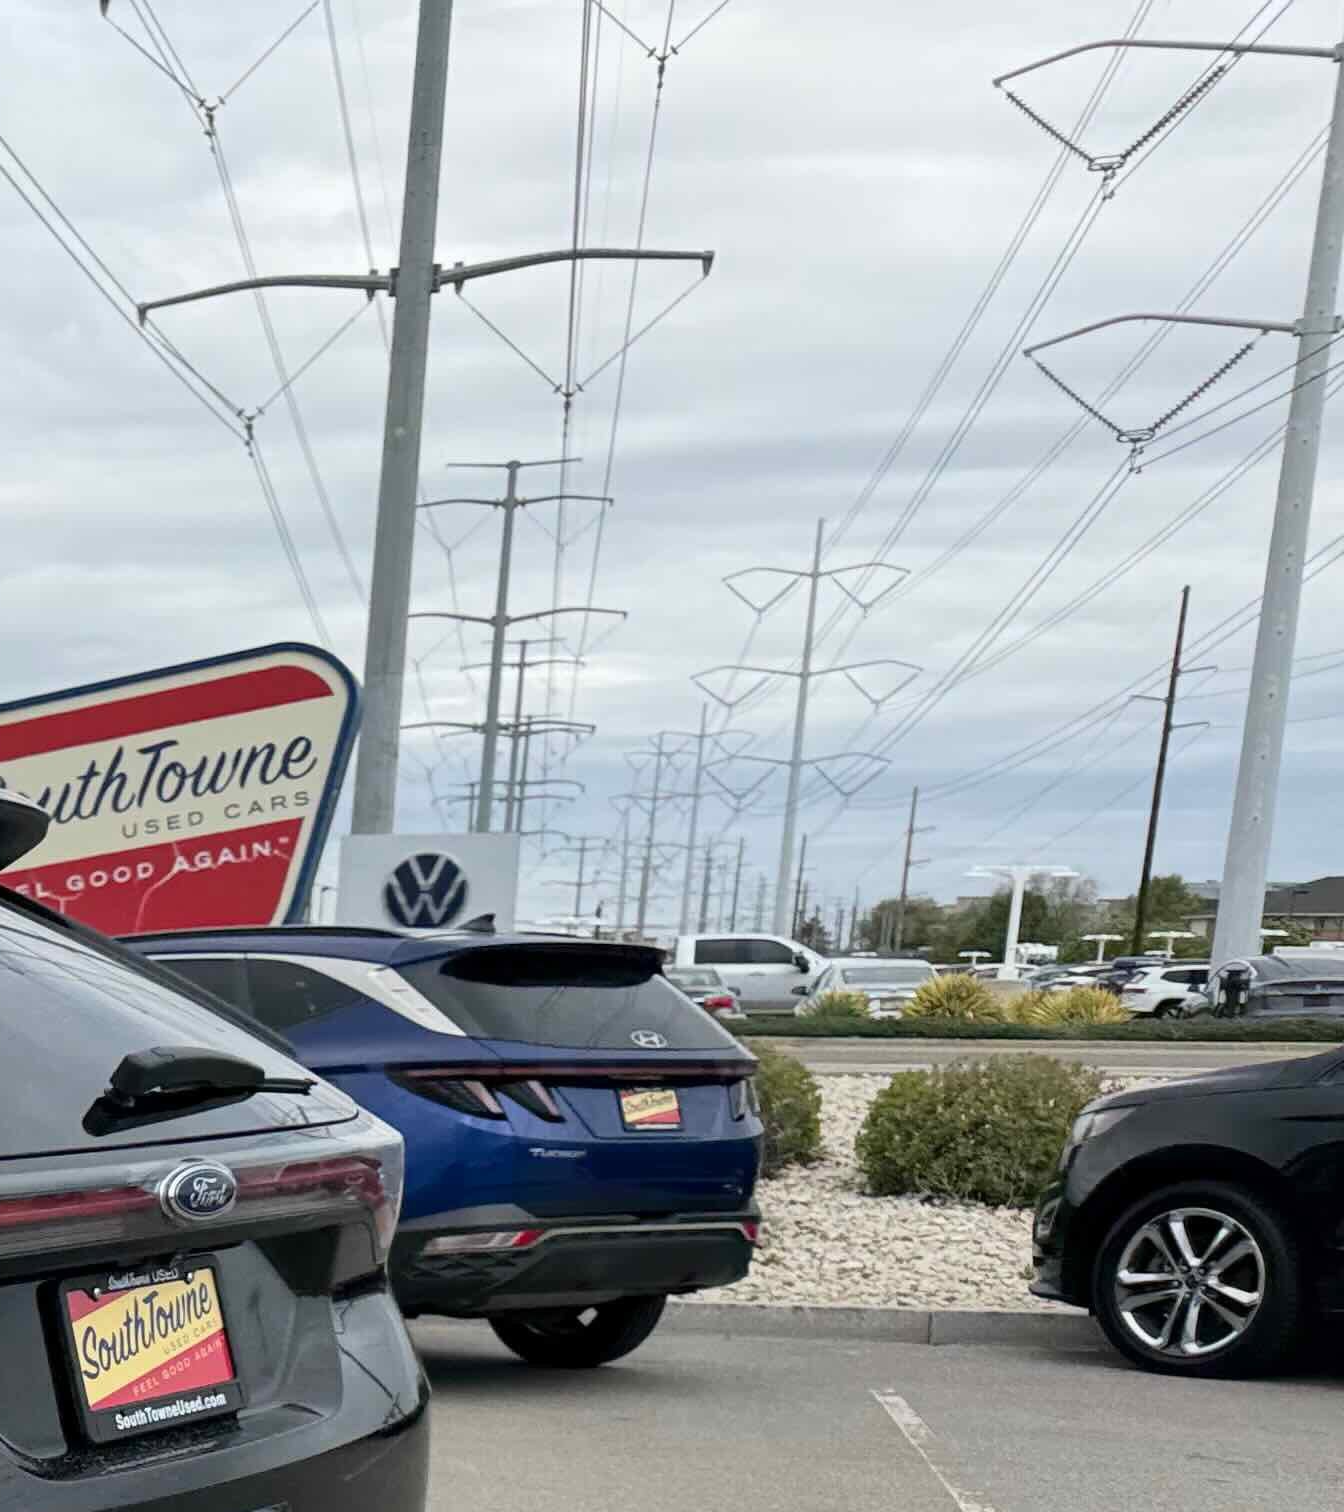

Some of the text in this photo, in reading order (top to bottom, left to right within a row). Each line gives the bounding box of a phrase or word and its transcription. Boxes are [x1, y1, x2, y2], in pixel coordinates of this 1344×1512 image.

[122, 790, 311, 839] USED CARS
[65, 862, 154, 892] GOOD
[82, 1282, 213, 1380] SouthTowne
[132, 1377, 160, 1397] FEEL
[161, 1357, 192, 1381] GOOD
[115, 1392, 227, 1431] SouthTowneUsed.com
